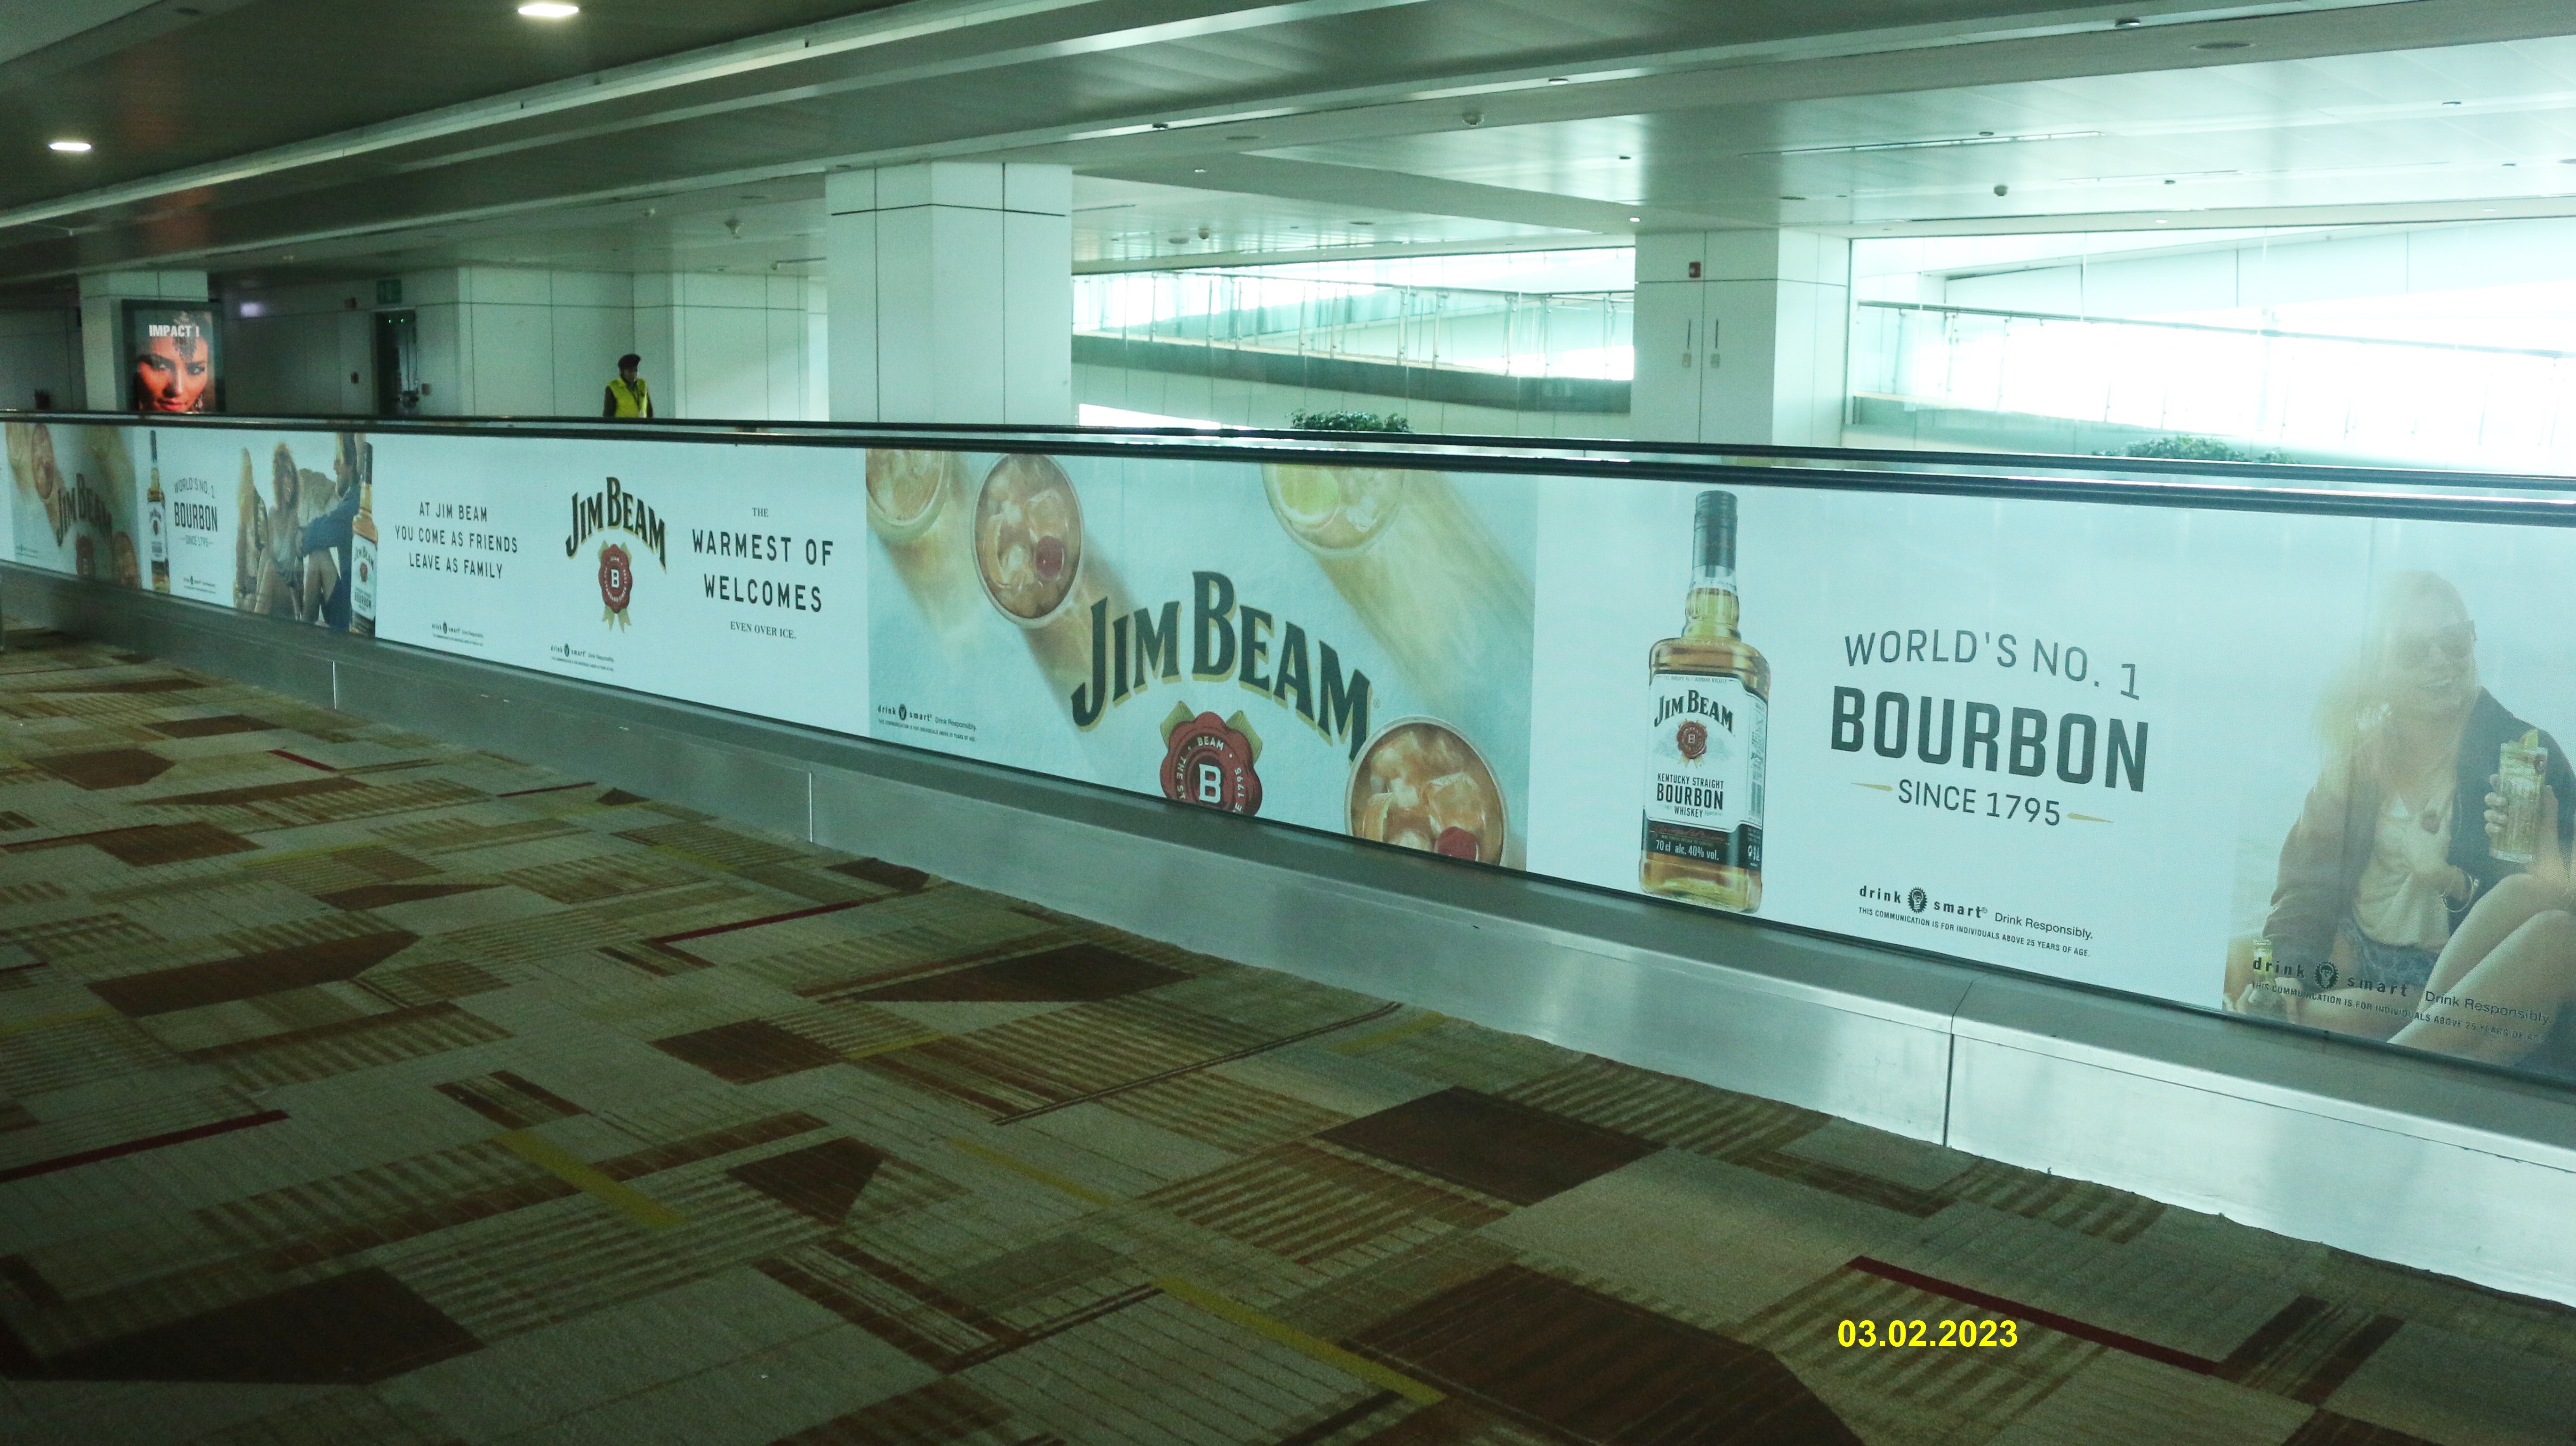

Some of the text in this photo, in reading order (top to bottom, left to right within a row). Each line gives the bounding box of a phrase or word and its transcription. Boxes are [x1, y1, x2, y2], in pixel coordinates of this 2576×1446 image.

[149, 324, 192, 337] IMPACT
[174, 502, 217, 531] BOURBON
[419, 502, 487, 522] AT JIM BEAM
[565, 477, 667, 574] JIM BEAM
[752, 507, 769, 517] THE
[395, 525, 517, 553] YOU COME AS FRIENDS
[692, 529, 833, 566] WARMEST OF
[409, 552, 502, 579] LEAVE AS FAMILY
[611, 569, 620, 588] B
[704, 573, 821, 612] WELCOMES
[731, 621, 796, 639] EVEN OVER ICE.
[1071, 570, 1373, 765] JIM BEAM
[1845, 629, 2139, 700] WORLD'S NO. 1
[877, 705, 896, 715] drink
[1654, 689, 1734, 734] JIM BEAM
[1197, 736, 1224, 751] BEAM
[1831, 685, 2148, 792] BOURBON
[1176, 756, 1187, 779] THE
[1658, 772, 1724, 789] KENTUCKY STRAIGHT
[1199, 763, 1221, 804] B
[1234, 767, 1245, 798] 1795
[1657, 783, 1723, 810] BOURBON
[1674, 806, 1703, 818] WHISKEY
[1899, 779, 2060, 826] SINCE 1795
[1656, 839, 1664, 851] 70
[1665, 841, 1671, 852] cl
[1675, 843, 1687, 855] alc.
[1688, 845, 1704, 858] 40%
[1707, 849, 1719, 860] vol.
[1859, 885, 1901, 903] drink
[1995, 912, 2022, 925] Drink
[2026, 918, 2093, 940] Responsibly.
[1859, 907, 1873, 916] THIS
[1875, 910, 1930, 926] COMMUNICATION
[1941, 922, 1954, 931] FOR
[1956, 925, 1999, 940] INDIVIDUALS
[2002, 934, 2025, 944] ABOVE
[2026, 939, 2035, 947] 25
[2038, 941, 2060, 951] YEARS
[2074, 948, 2090, 957] AGE.
[2252, 981, 2269, 990] THIS
[2344, 998, 2352, 1006] IS
[2355, 1001, 2372, 1011] FOR
[2433, 1015, 2462, 1028] ABOVE
[2253, 957, 2552, 1025] drink smart Drink Responsibly.
